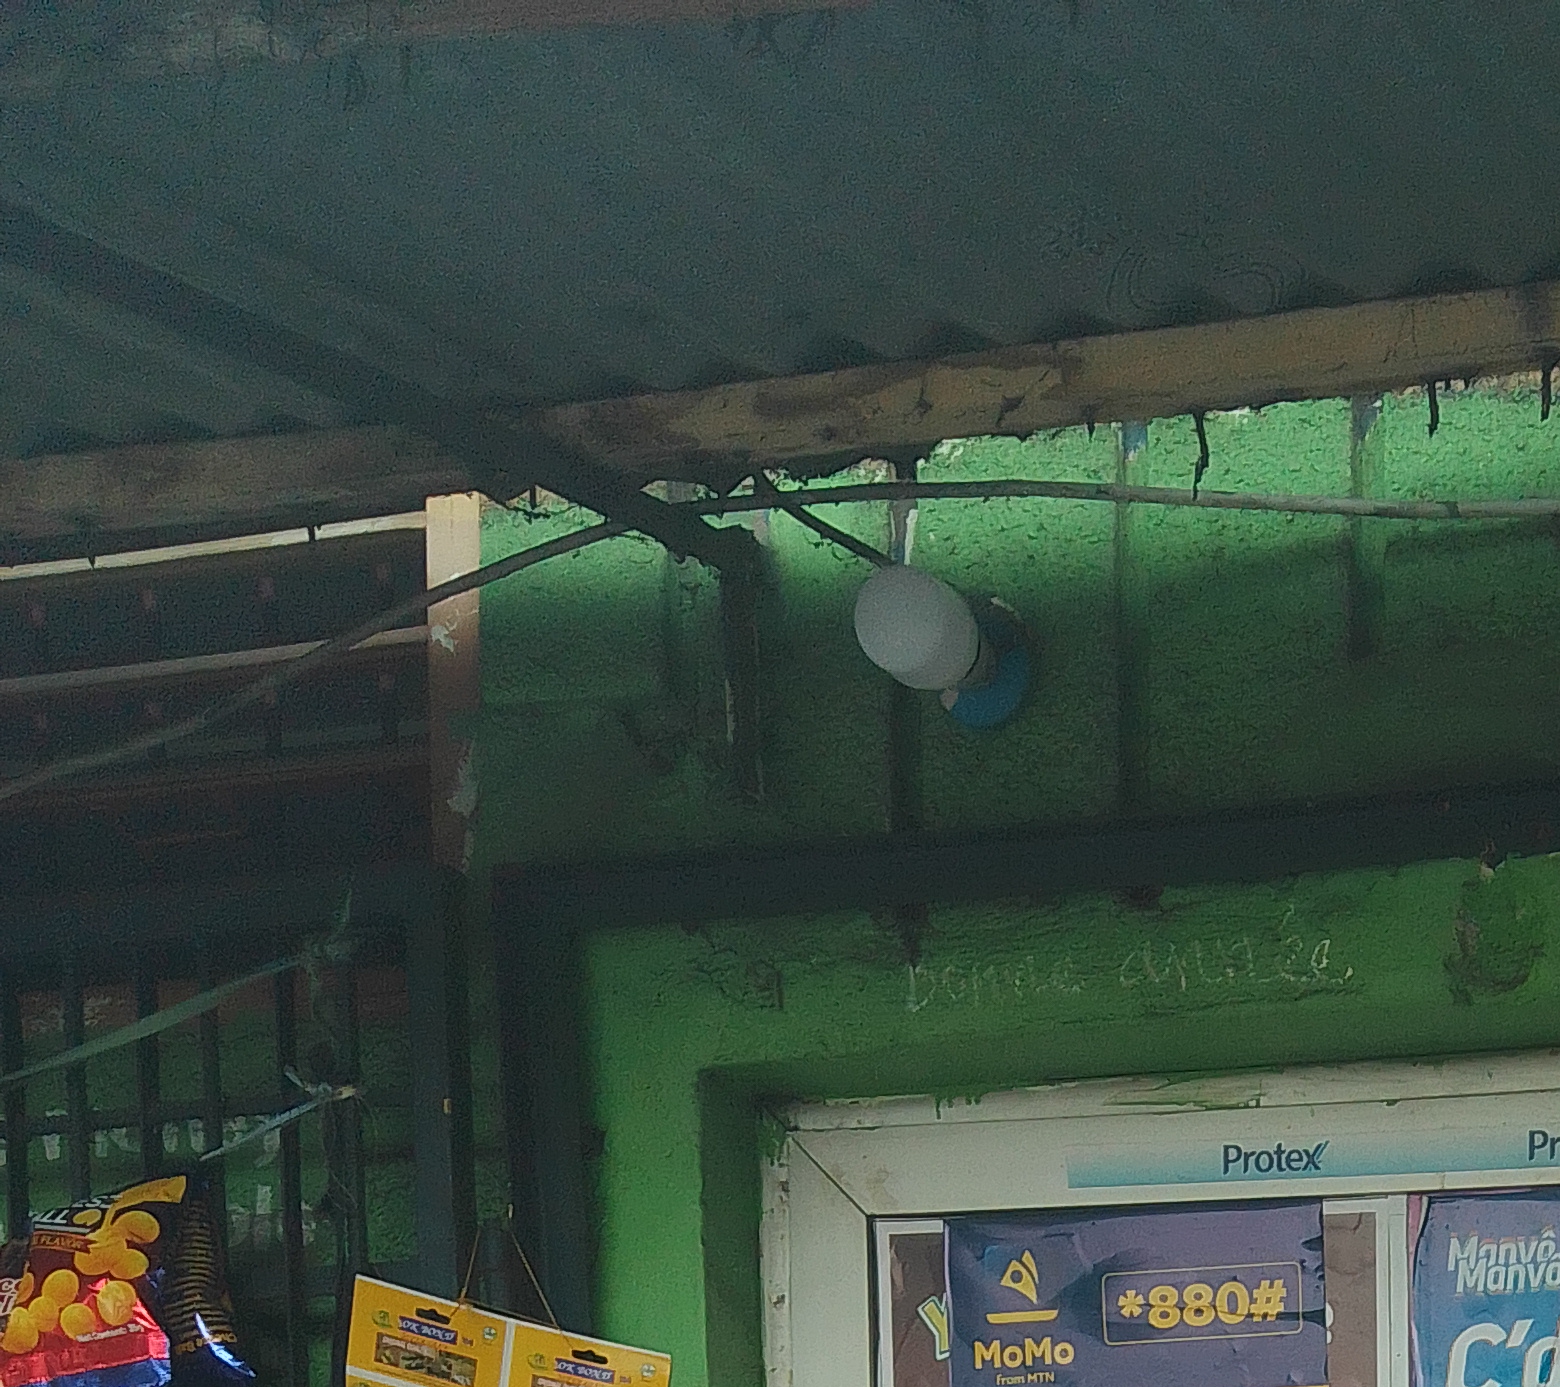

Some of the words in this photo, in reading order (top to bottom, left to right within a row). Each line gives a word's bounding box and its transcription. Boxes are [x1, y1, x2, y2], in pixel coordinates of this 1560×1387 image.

[1222, 1140, 1330, 1176] Protex
[973, 1337, 1075, 1369] MoMo
[996, 1373, 1024, 1386] from
[1027, 1371, 1055, 1385] MTN
